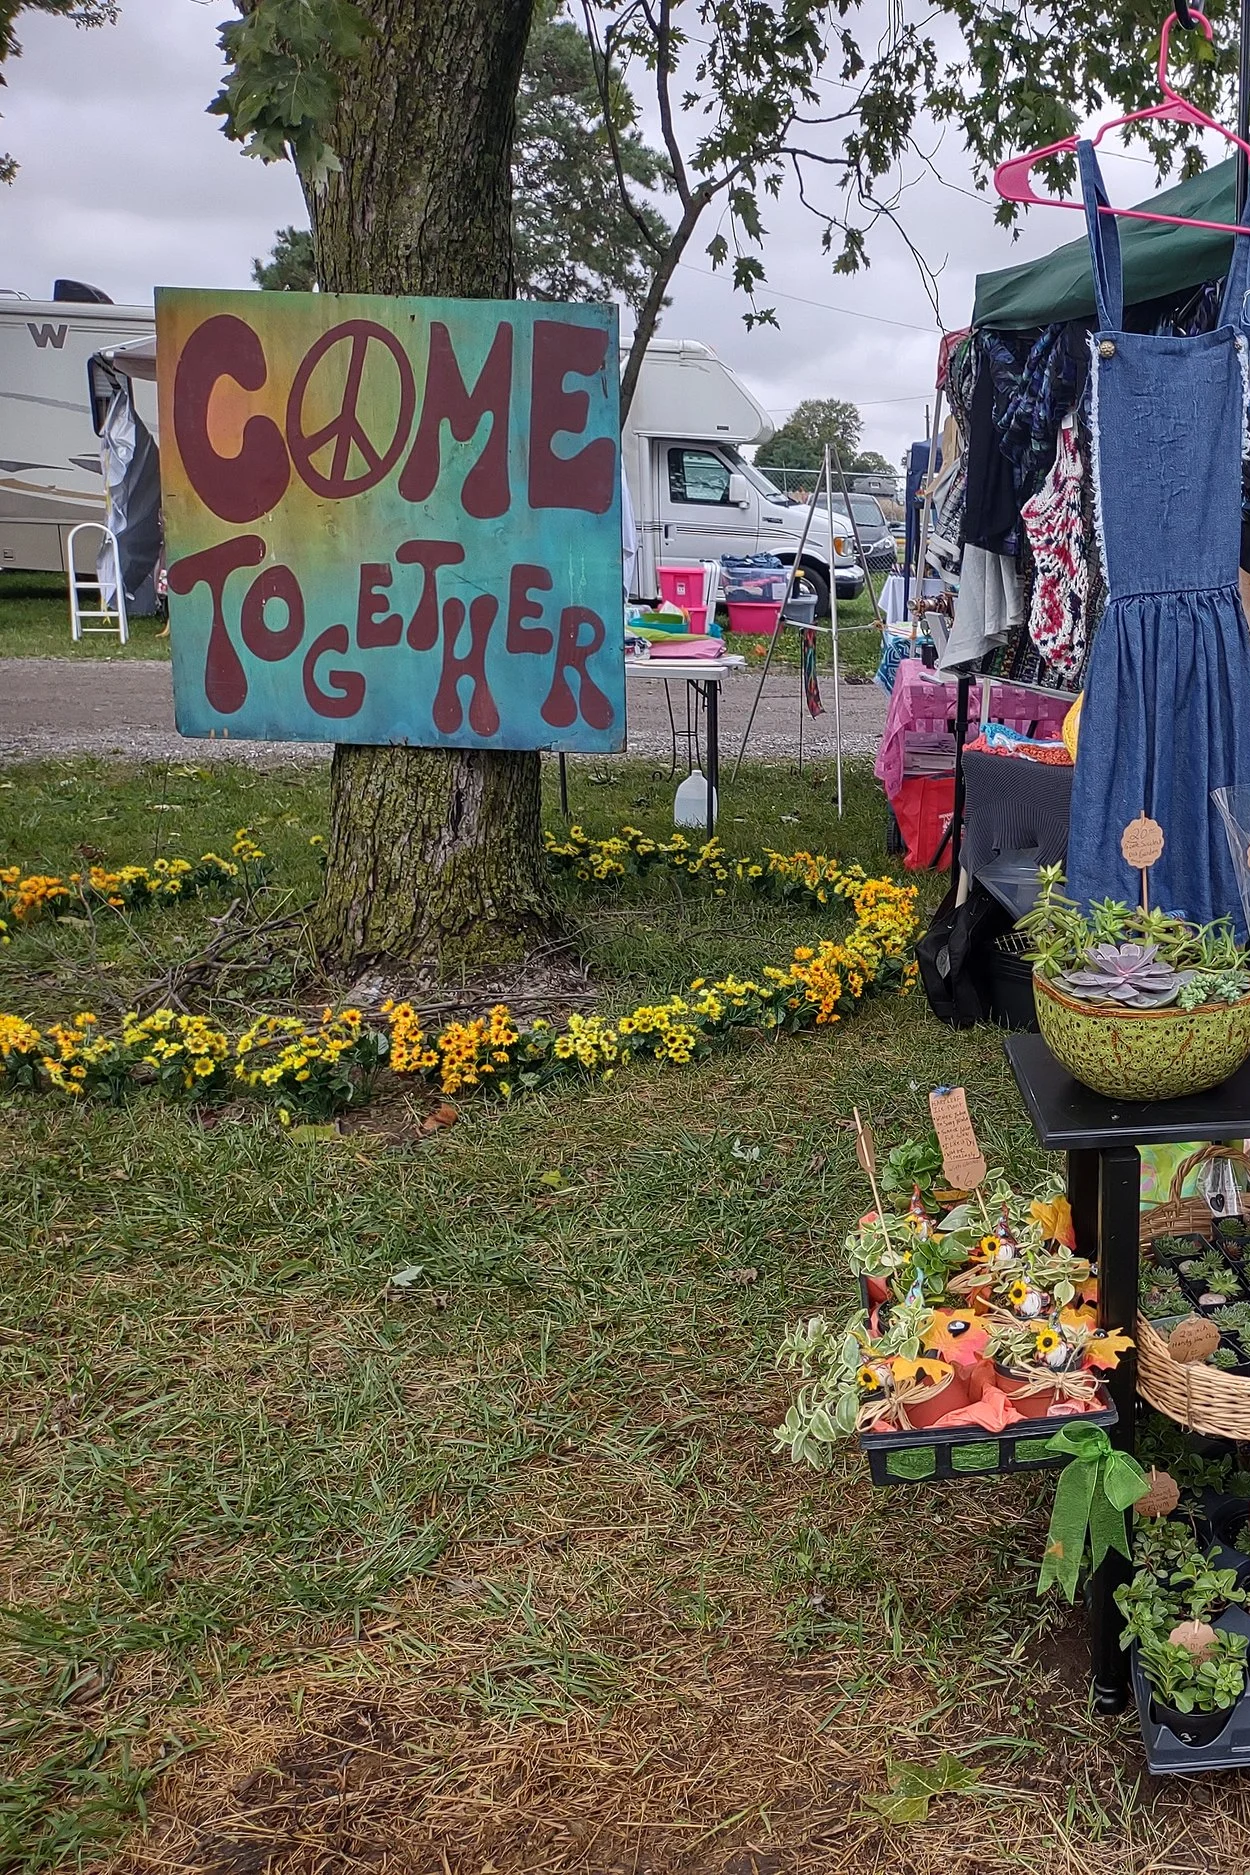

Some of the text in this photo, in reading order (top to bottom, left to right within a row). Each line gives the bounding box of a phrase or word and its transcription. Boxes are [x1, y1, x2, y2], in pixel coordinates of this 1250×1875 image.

[27, 322, 69, 349] W
[173, 313, 615, 524] COME
[167, 533, 616, 738] TOGETHER
